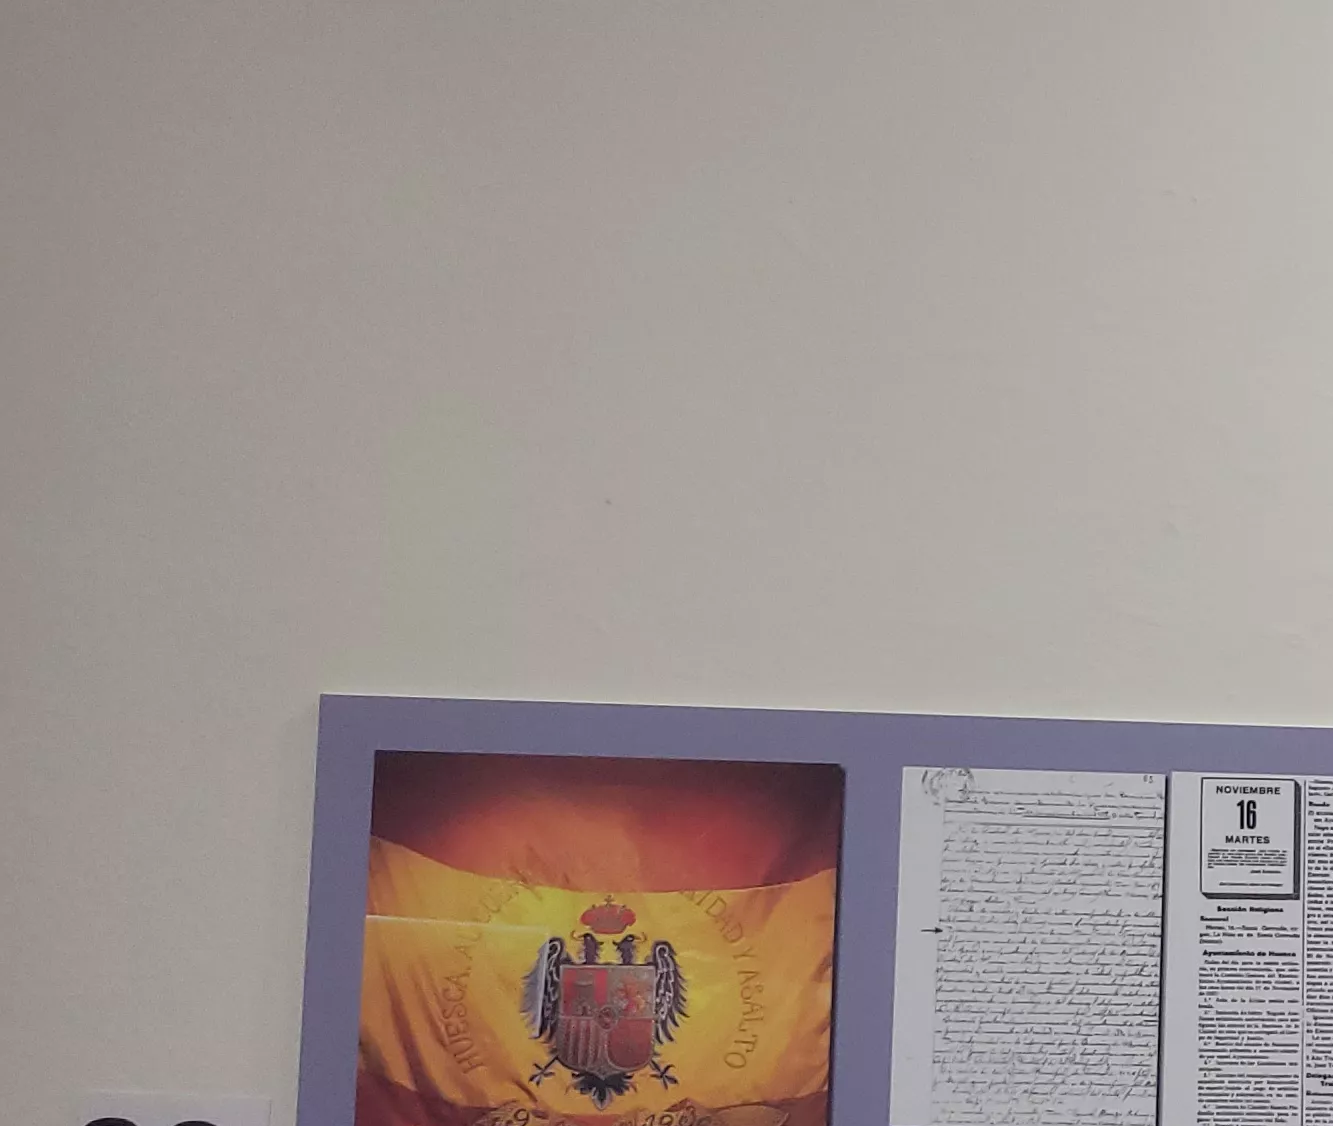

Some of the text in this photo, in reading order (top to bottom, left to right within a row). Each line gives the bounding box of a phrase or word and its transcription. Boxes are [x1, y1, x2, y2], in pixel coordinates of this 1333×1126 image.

[1216, 785, 1281, 795] NOVIEMBRE
[1236, 799, 1257, 830] 16
[1225, 835, 1271, 844] MARTES
[724, 969, 765, 1070] ASALTO
